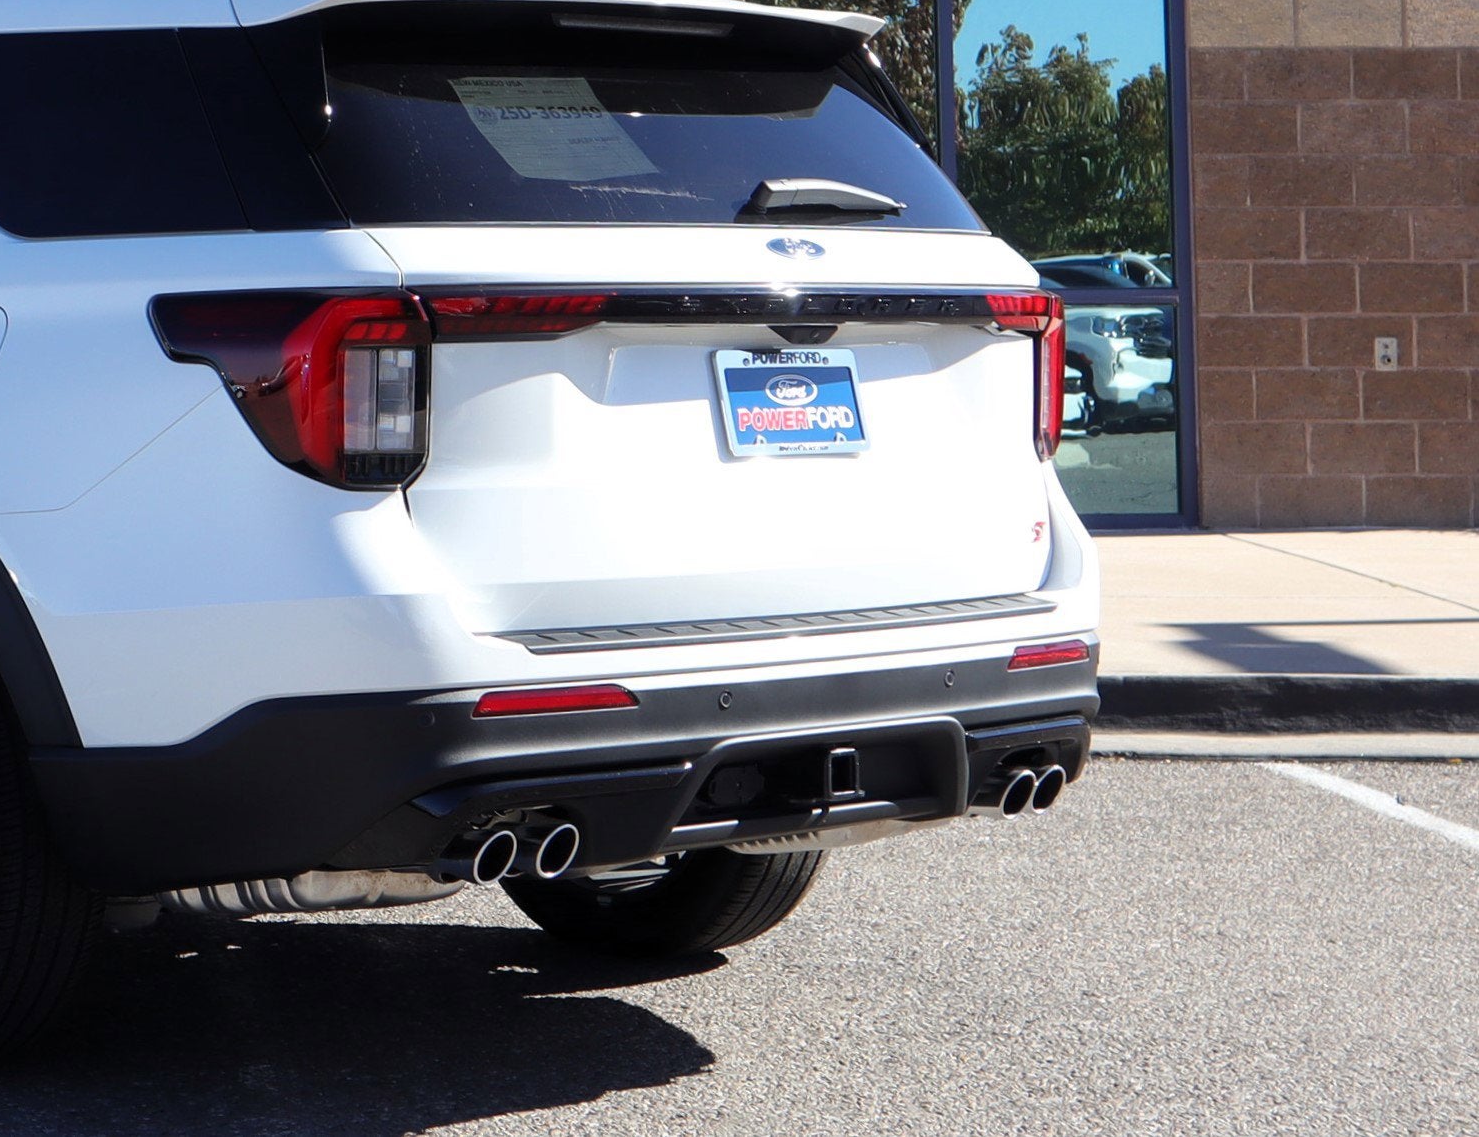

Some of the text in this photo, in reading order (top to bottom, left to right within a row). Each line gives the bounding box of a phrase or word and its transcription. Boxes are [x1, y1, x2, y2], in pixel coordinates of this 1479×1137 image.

[472, 79, 504, 88] MEXICO
[506, 79, 523, 88] USA
[752, 351, 821, 366] POWERFORD
[737, 405, 855, 432] POWERFORD
